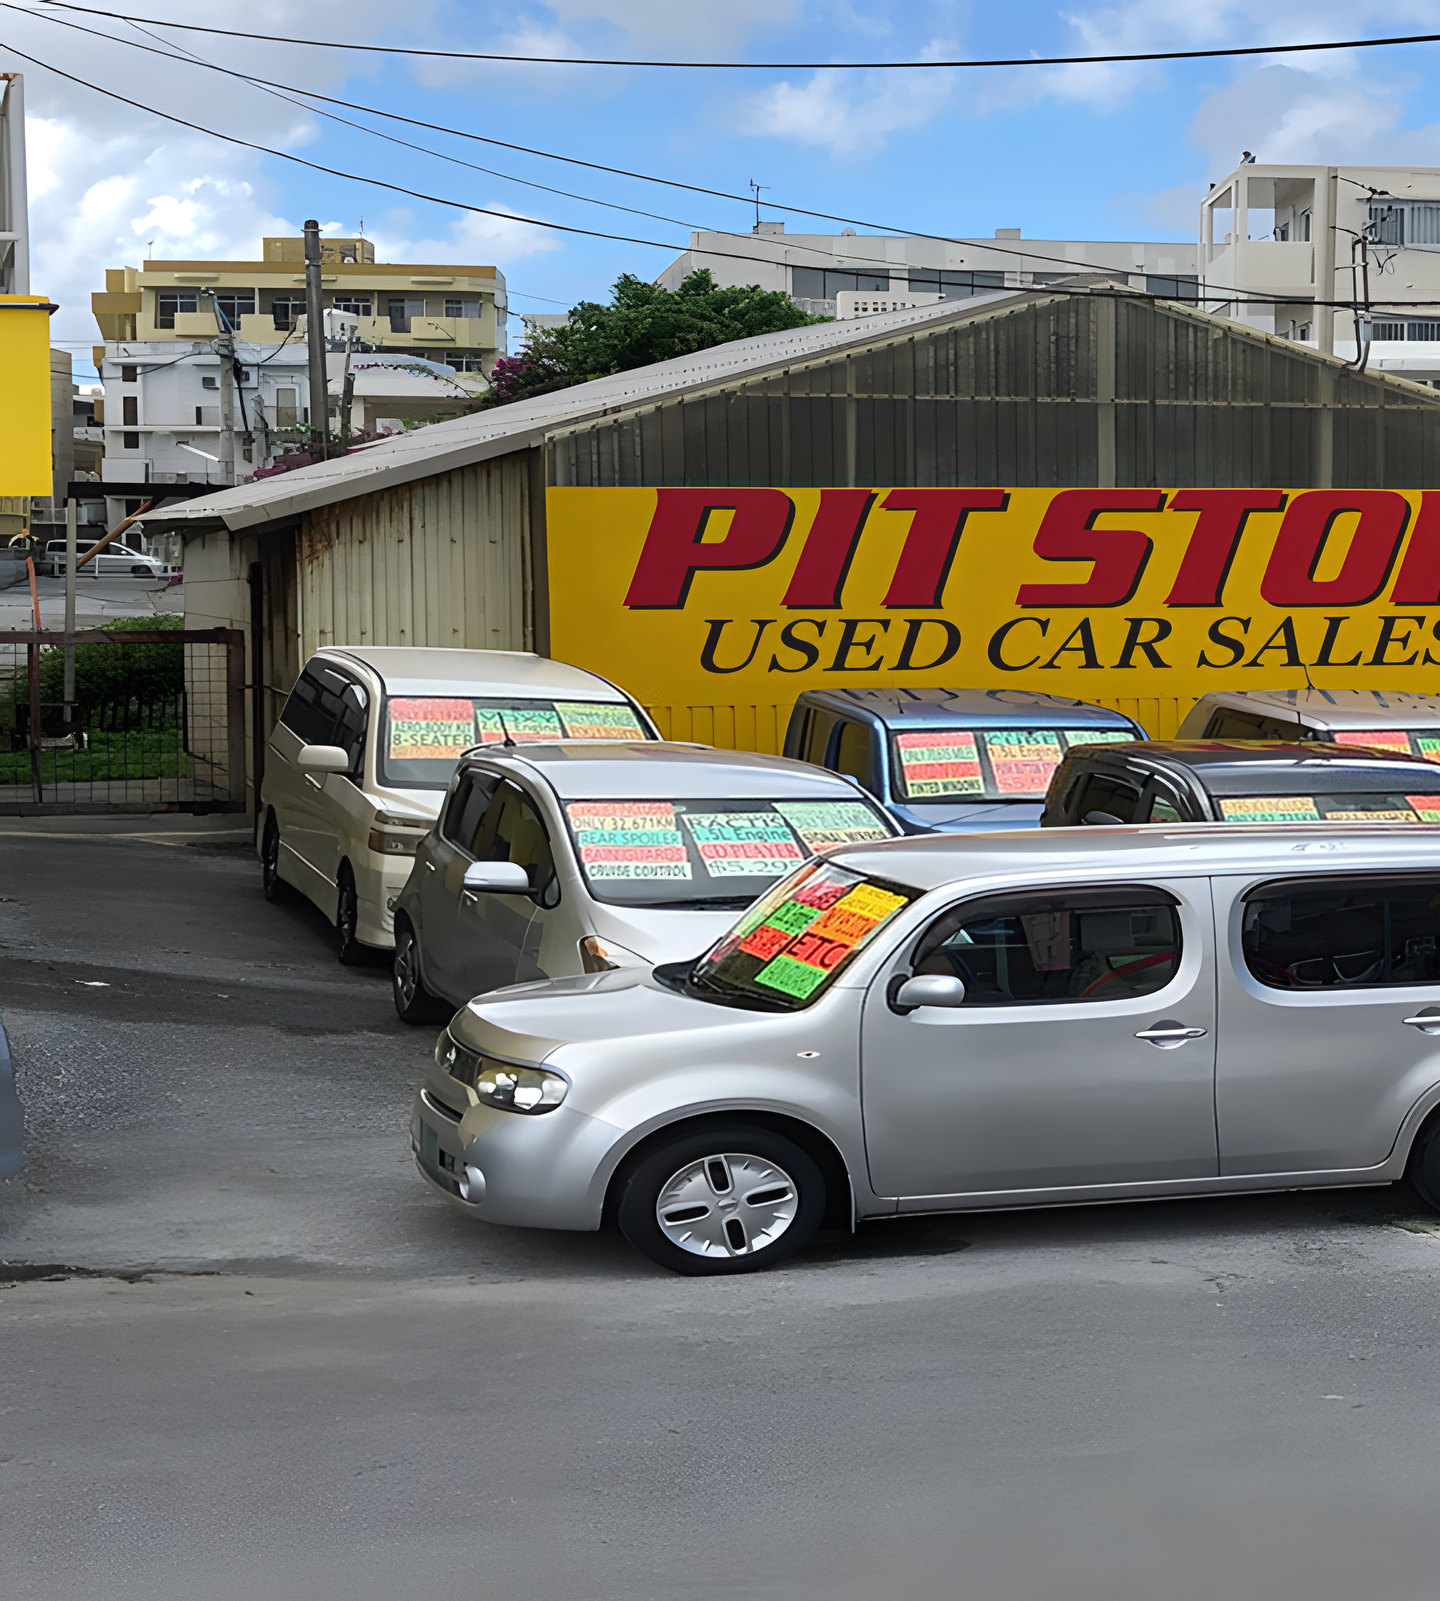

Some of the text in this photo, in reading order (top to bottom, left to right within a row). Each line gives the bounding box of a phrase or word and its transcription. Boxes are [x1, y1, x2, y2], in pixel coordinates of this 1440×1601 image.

[622, 487, 1012, 611] PIT
[699, 617, 962, 675] USED
[987, 616, 1173, 673] CAR
[392, 733, 474, 747] 8-SEATER
[572, 817, 607, 830] ONLY
[687, 813, 785, 830] RACTIS
[580, 831, 680, 845] REAR SPOILER
[734, 827, 792, 843] Engine
[700, 842, 800, 859] CD PLAYER
[588, 864, 687, 878] CRUISE CONTROL
[786, 931, 851, 968] ETC
